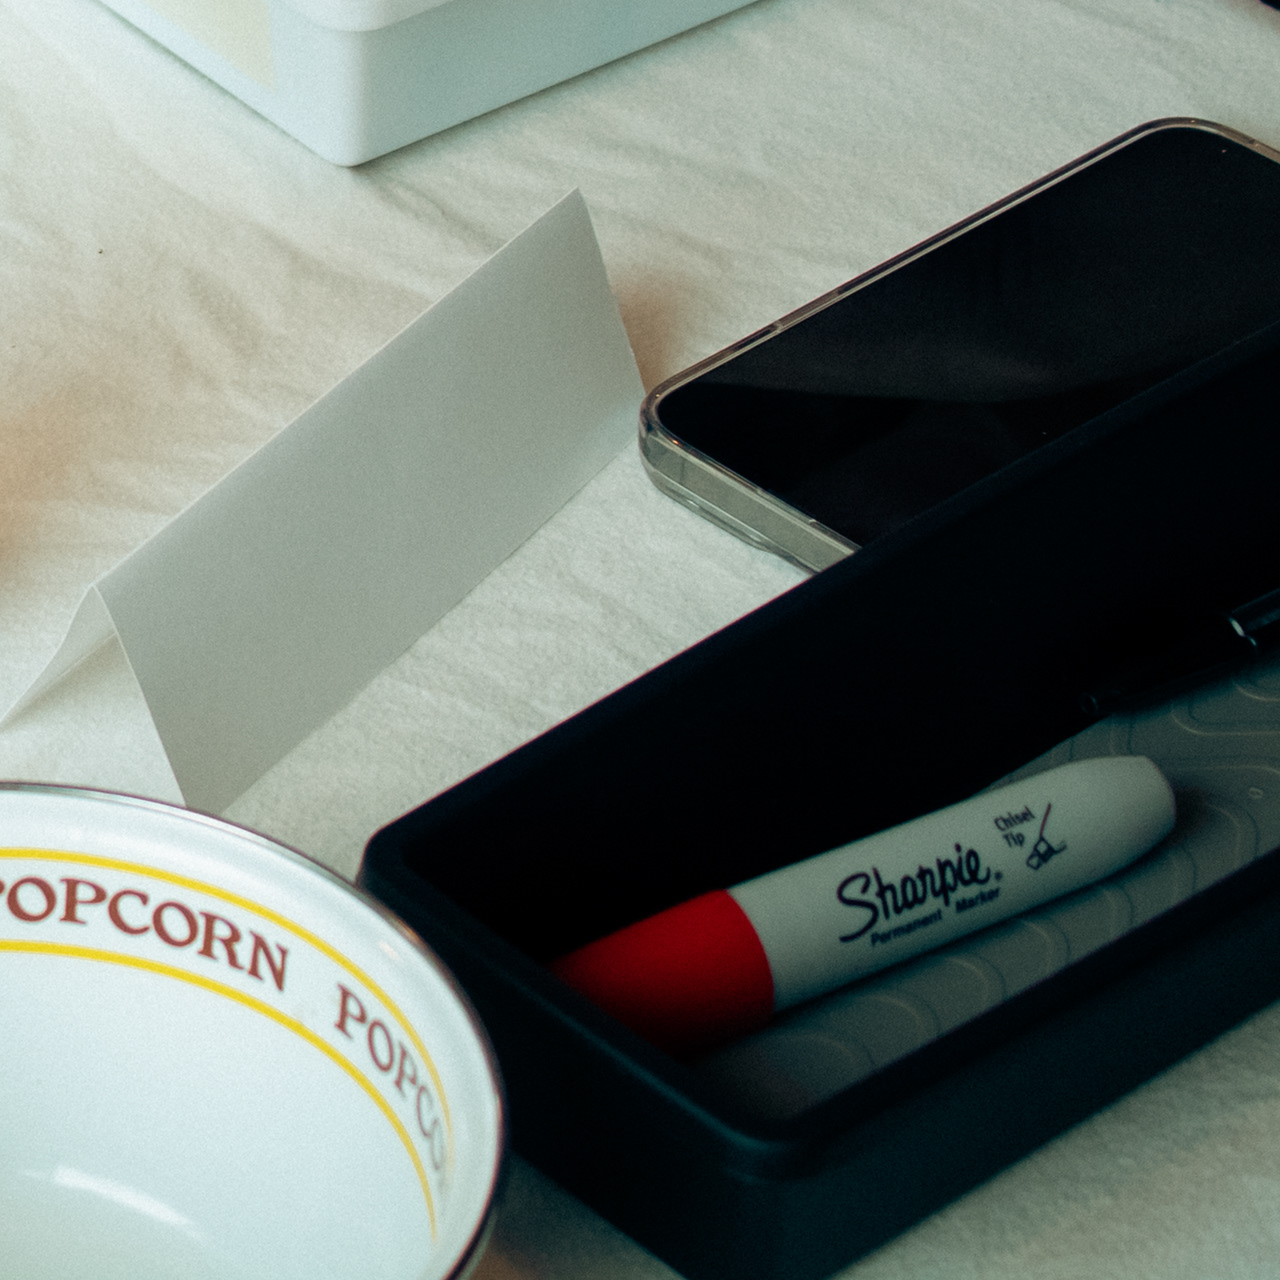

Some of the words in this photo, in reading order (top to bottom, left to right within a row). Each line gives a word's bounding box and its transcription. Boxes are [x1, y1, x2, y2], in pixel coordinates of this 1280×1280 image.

[994, 804, 1036, 832] Chisel
[1002, 832, 1026, 848] Tip
[837, 842, 991, 943] Sharpie
[870, 908, 943, 947] Permanent
[955, 887, 1001, 914] Marker
